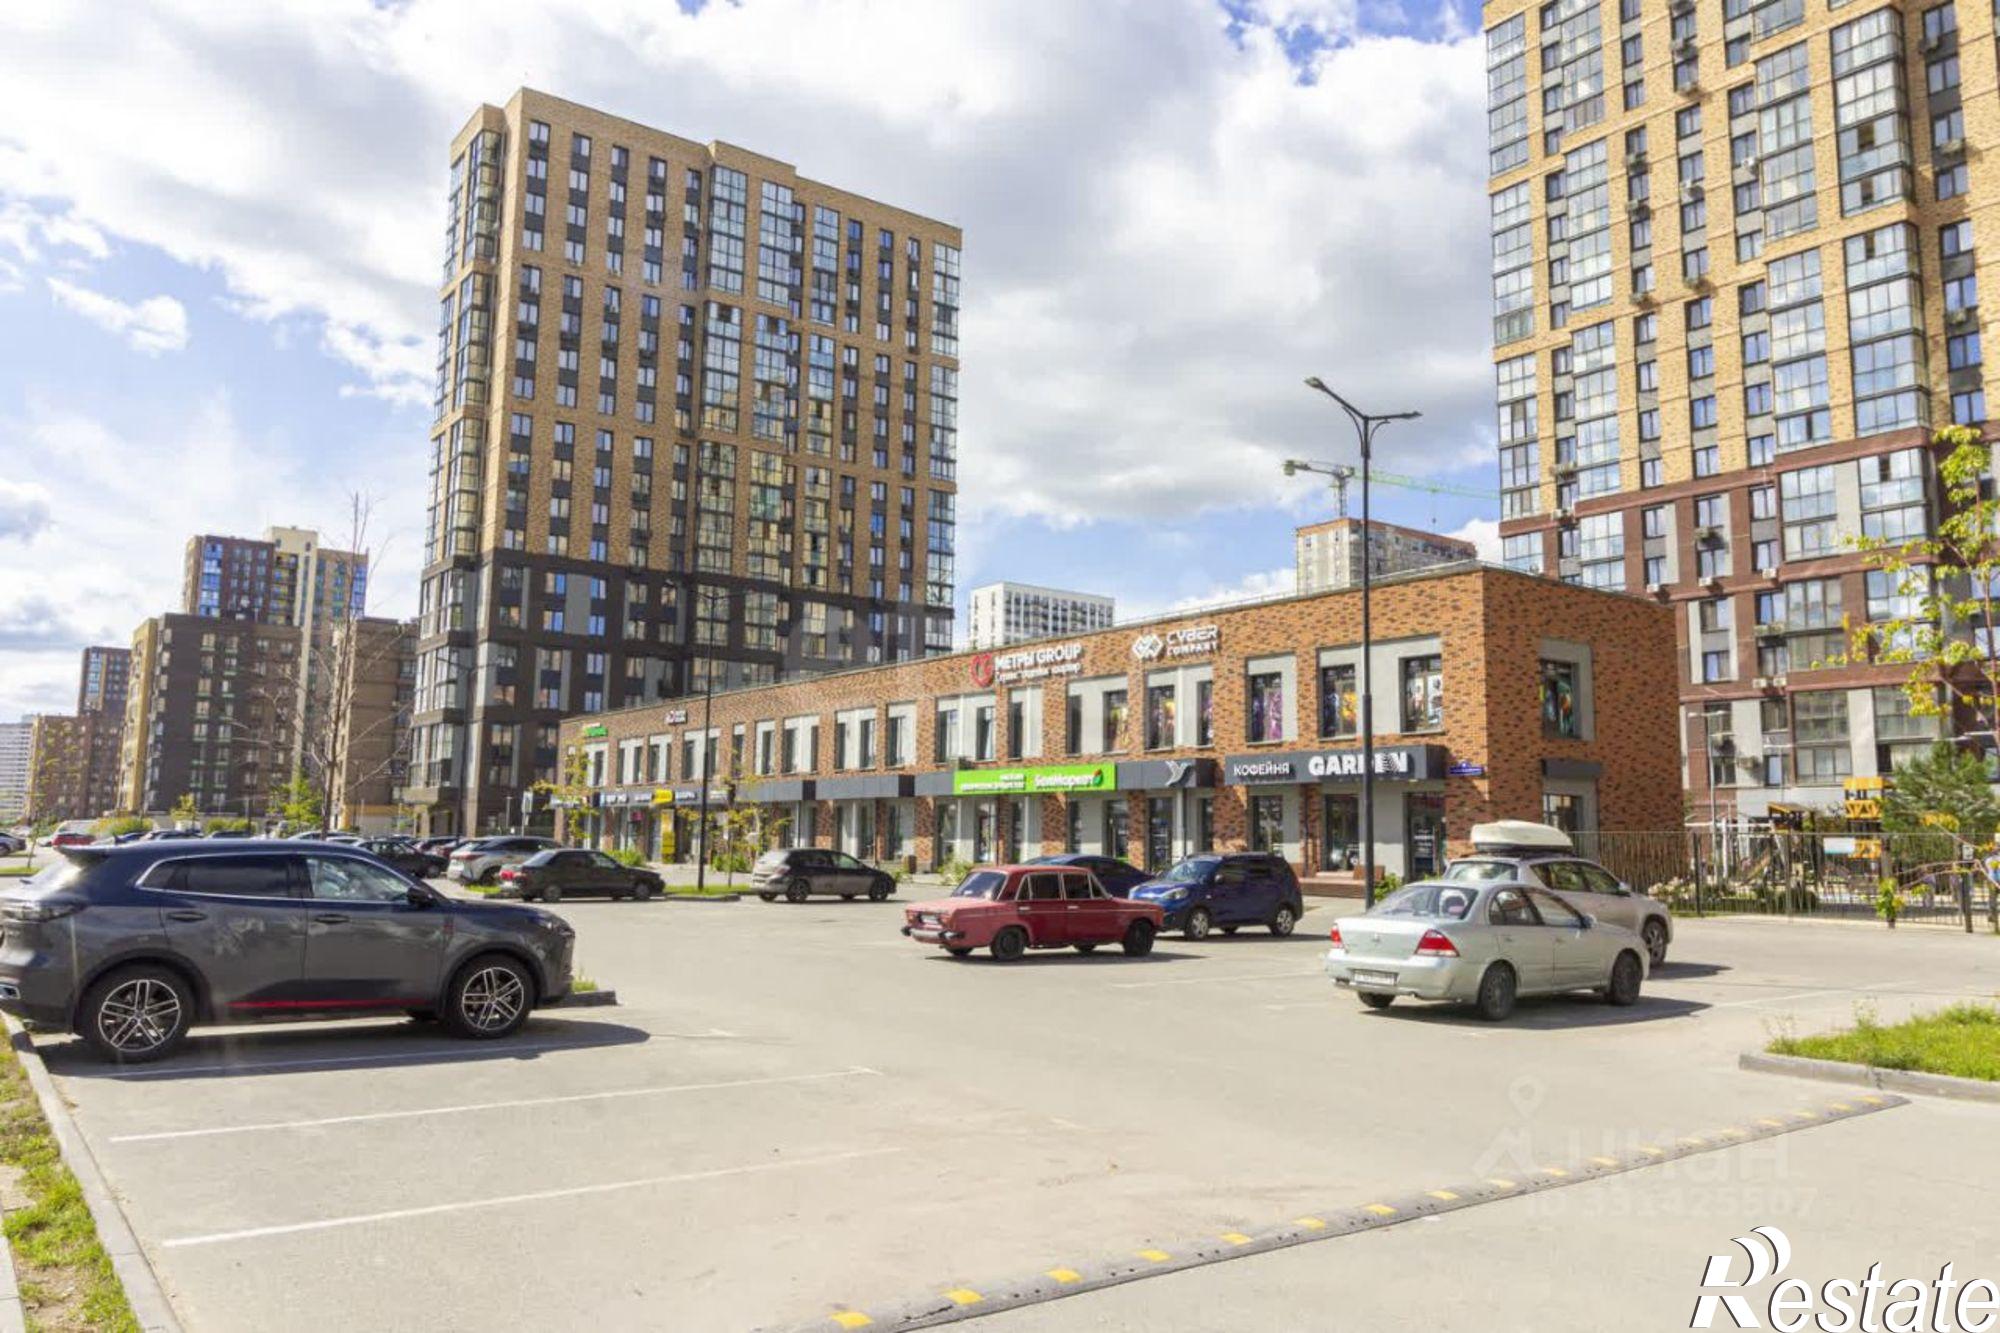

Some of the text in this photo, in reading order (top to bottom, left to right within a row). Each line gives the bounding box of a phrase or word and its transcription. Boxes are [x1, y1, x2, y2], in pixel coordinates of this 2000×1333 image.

[1166, 625, 1218, 644] CYBER
[995, 642, 1082, 671] МЕТРЫ GROUP
[1233, 761, 1290, 776] КОФЕЙНЯ
